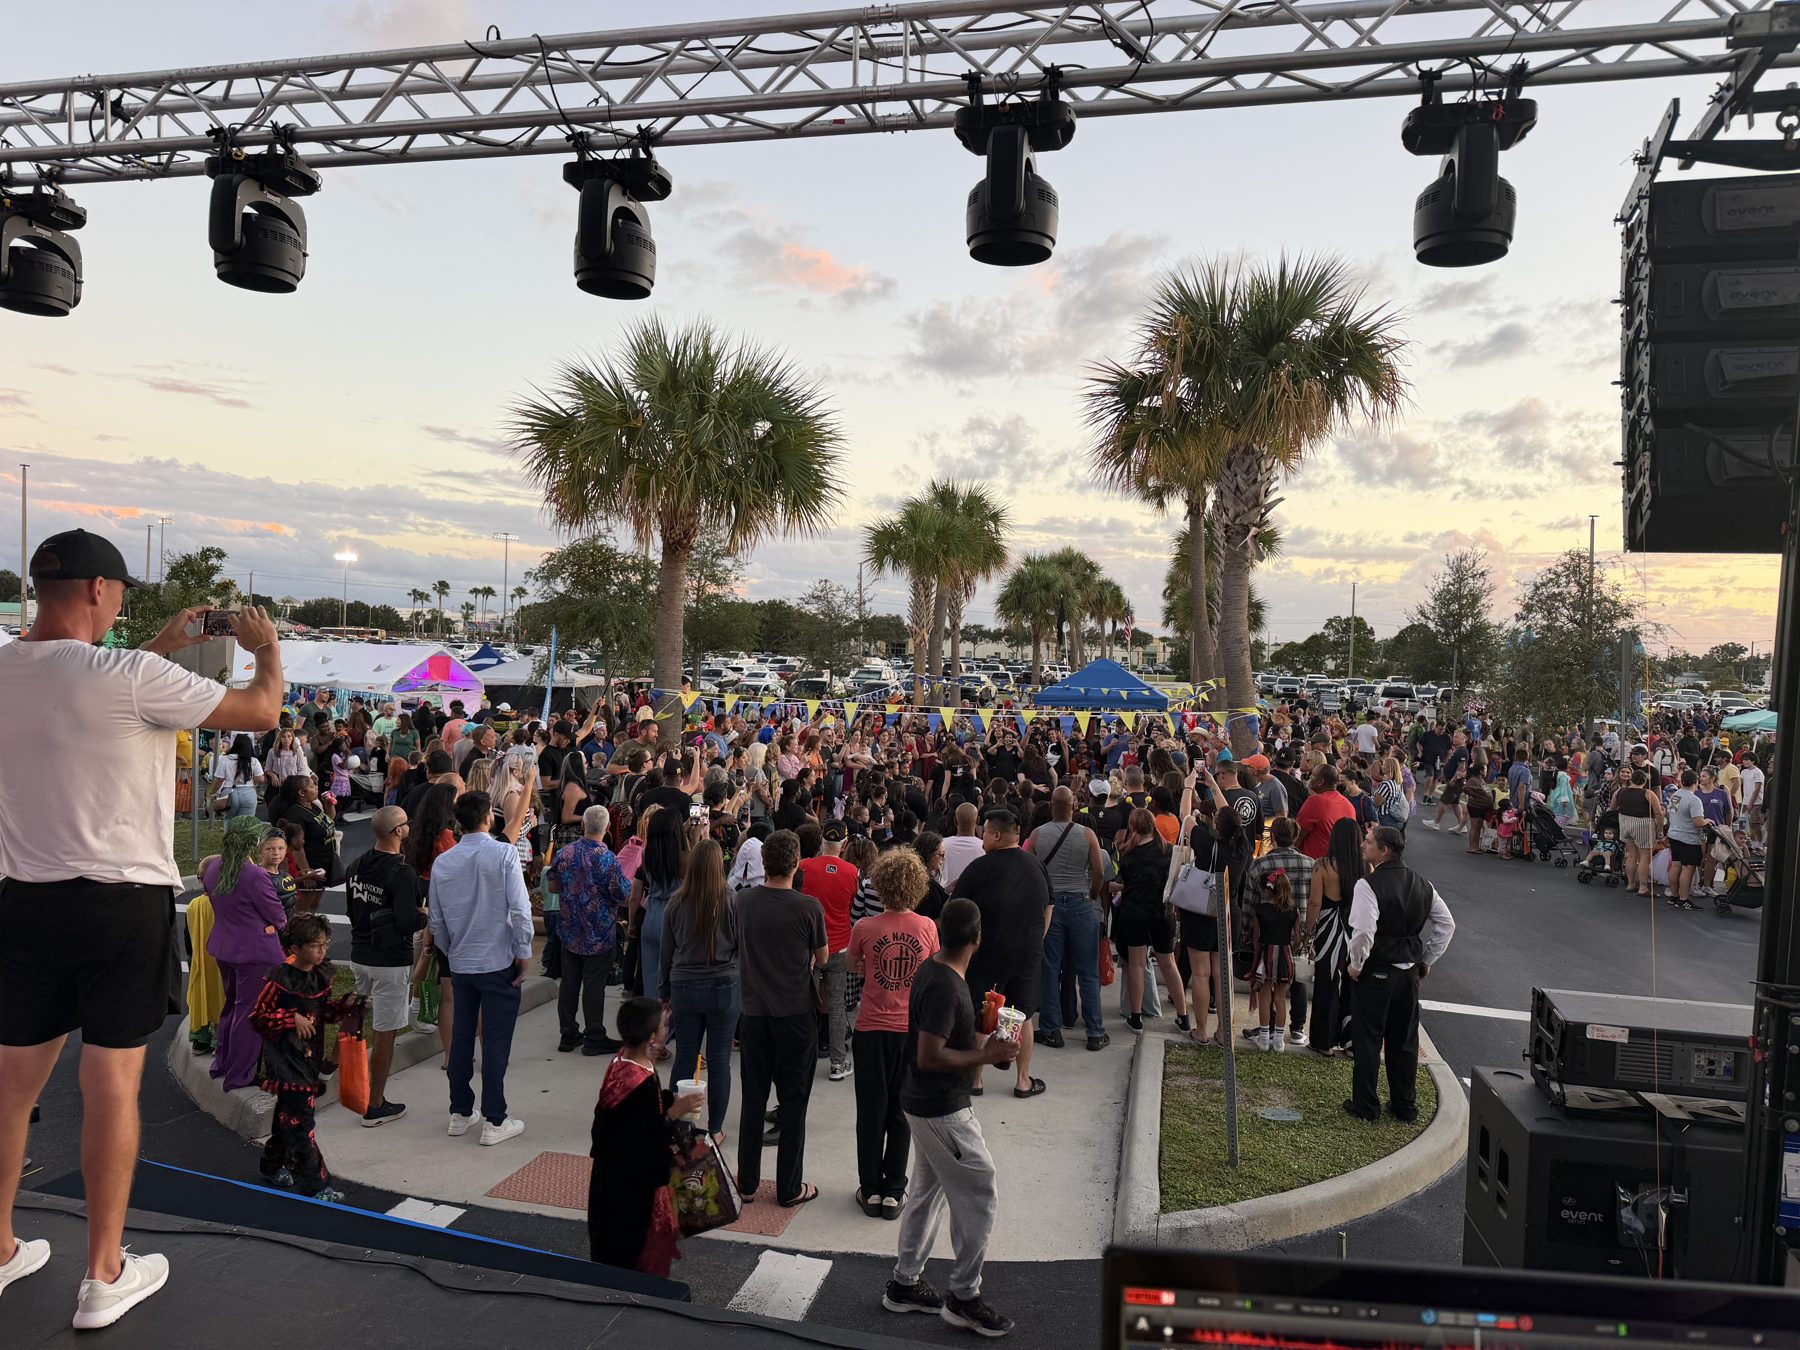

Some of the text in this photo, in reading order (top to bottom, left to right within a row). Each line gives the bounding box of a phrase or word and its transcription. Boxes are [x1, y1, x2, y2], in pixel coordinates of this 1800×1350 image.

[1727, 205, 1777, 217] event
[1729, 287, 1779, 300] event
[873, 932, 923, 953] ONE NATION
[874, 971, 900, 991] UNDER
[1561, 1209, 1604, 1222] event
